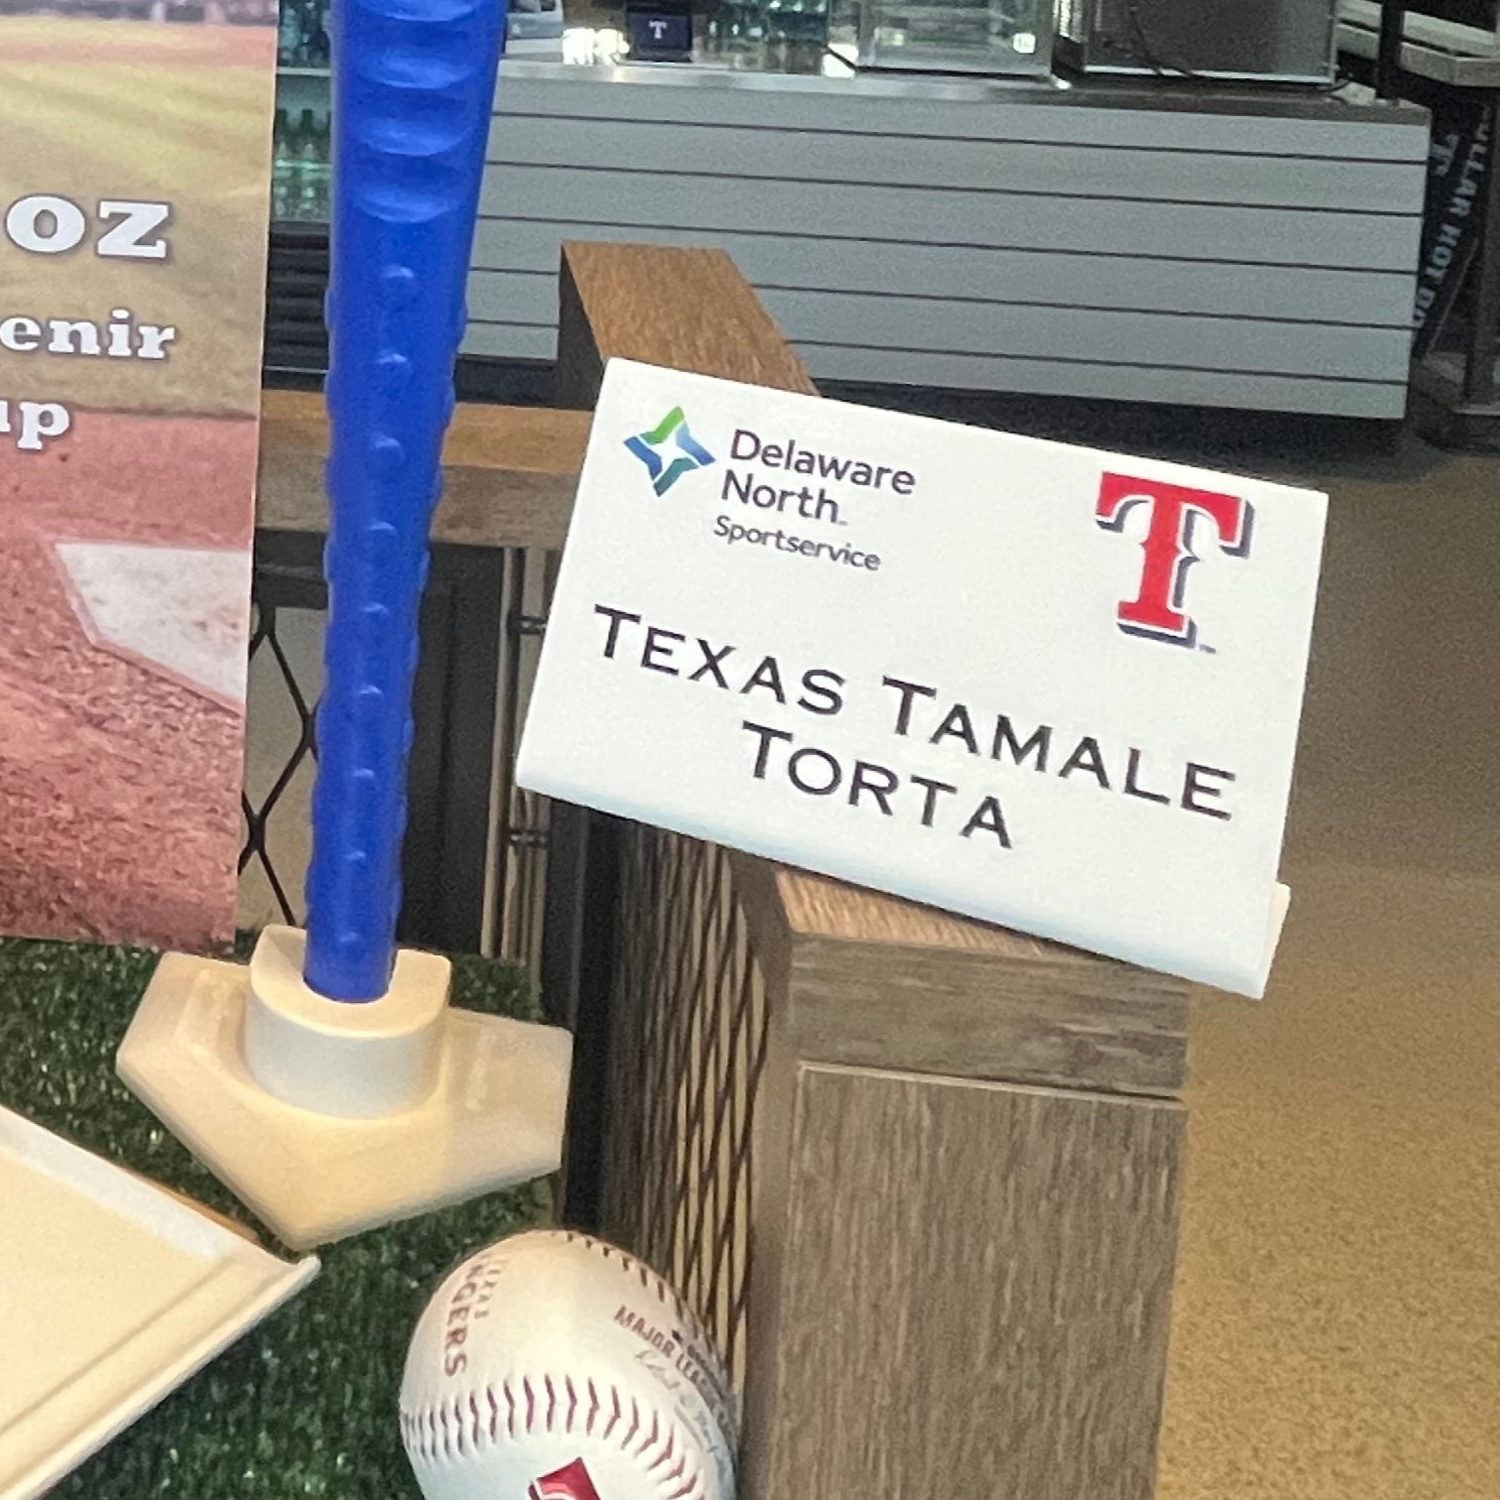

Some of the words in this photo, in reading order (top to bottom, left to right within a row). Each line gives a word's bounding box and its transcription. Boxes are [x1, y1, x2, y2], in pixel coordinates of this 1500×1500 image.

[729, 427, 919, 496] Delaware
[720, 469, 841, 526] North
[712, 513, 882, 572] Sportservice
[1096, 470, 1255, 649] T
[593, 602, 847, 717] TEXAS
[882, 676, 1237, 822] TAMALE
[741, 720, 1013, 849] TORTA
[614, 1303, 675, 1359] MAJOR
